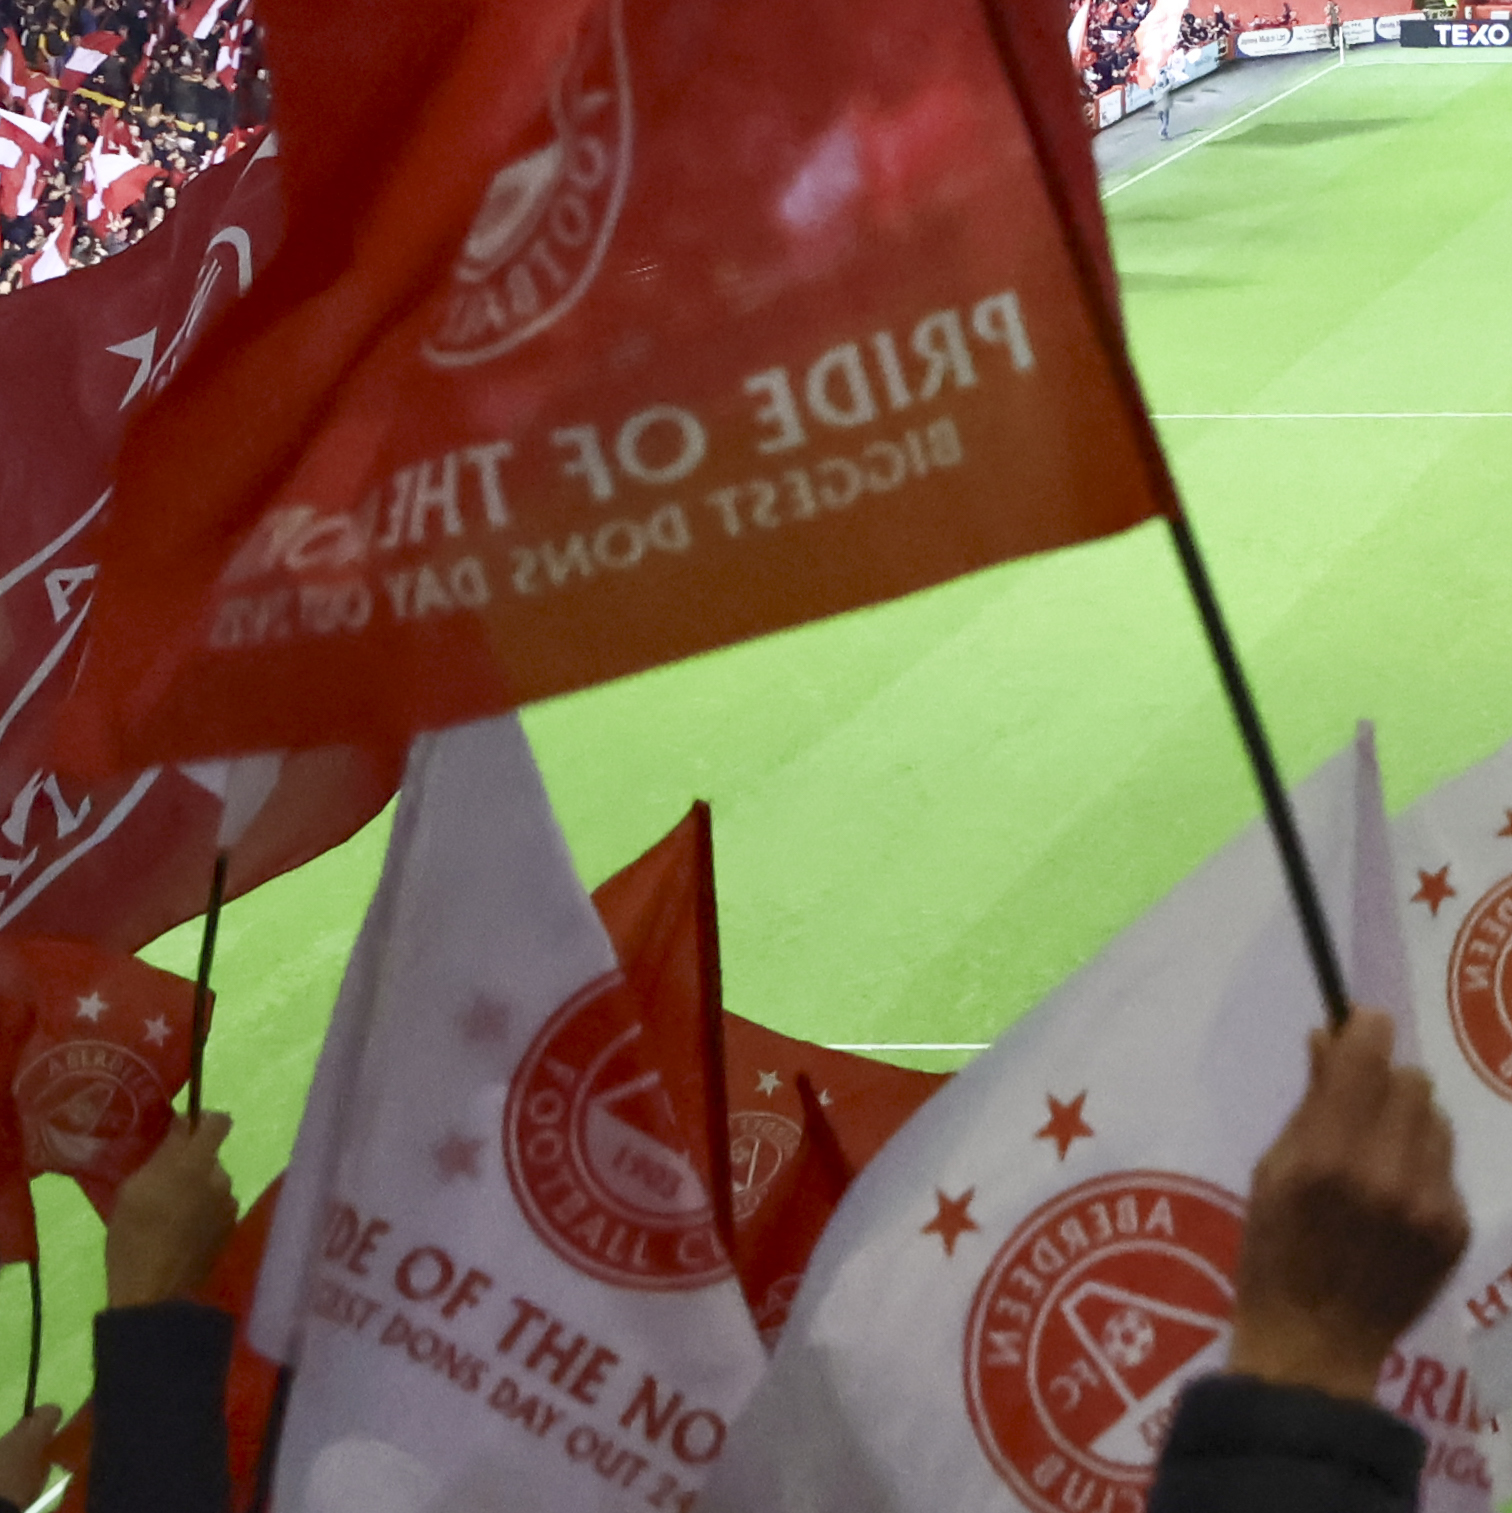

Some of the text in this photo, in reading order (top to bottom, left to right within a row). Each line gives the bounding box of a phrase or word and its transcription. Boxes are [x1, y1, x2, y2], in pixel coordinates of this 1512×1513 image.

[1434, 24, 1510, 46] TEXO
[378, 1311, 490, 1395] DONS
[488, 1375, 568, 1439] DAY
[565, 1424, 650, 1488] OUT
[394, 1246, 493, 1321] OF
[496, 1295, 621, 1407] THE
[619, 1373, 727, 1467] NO
